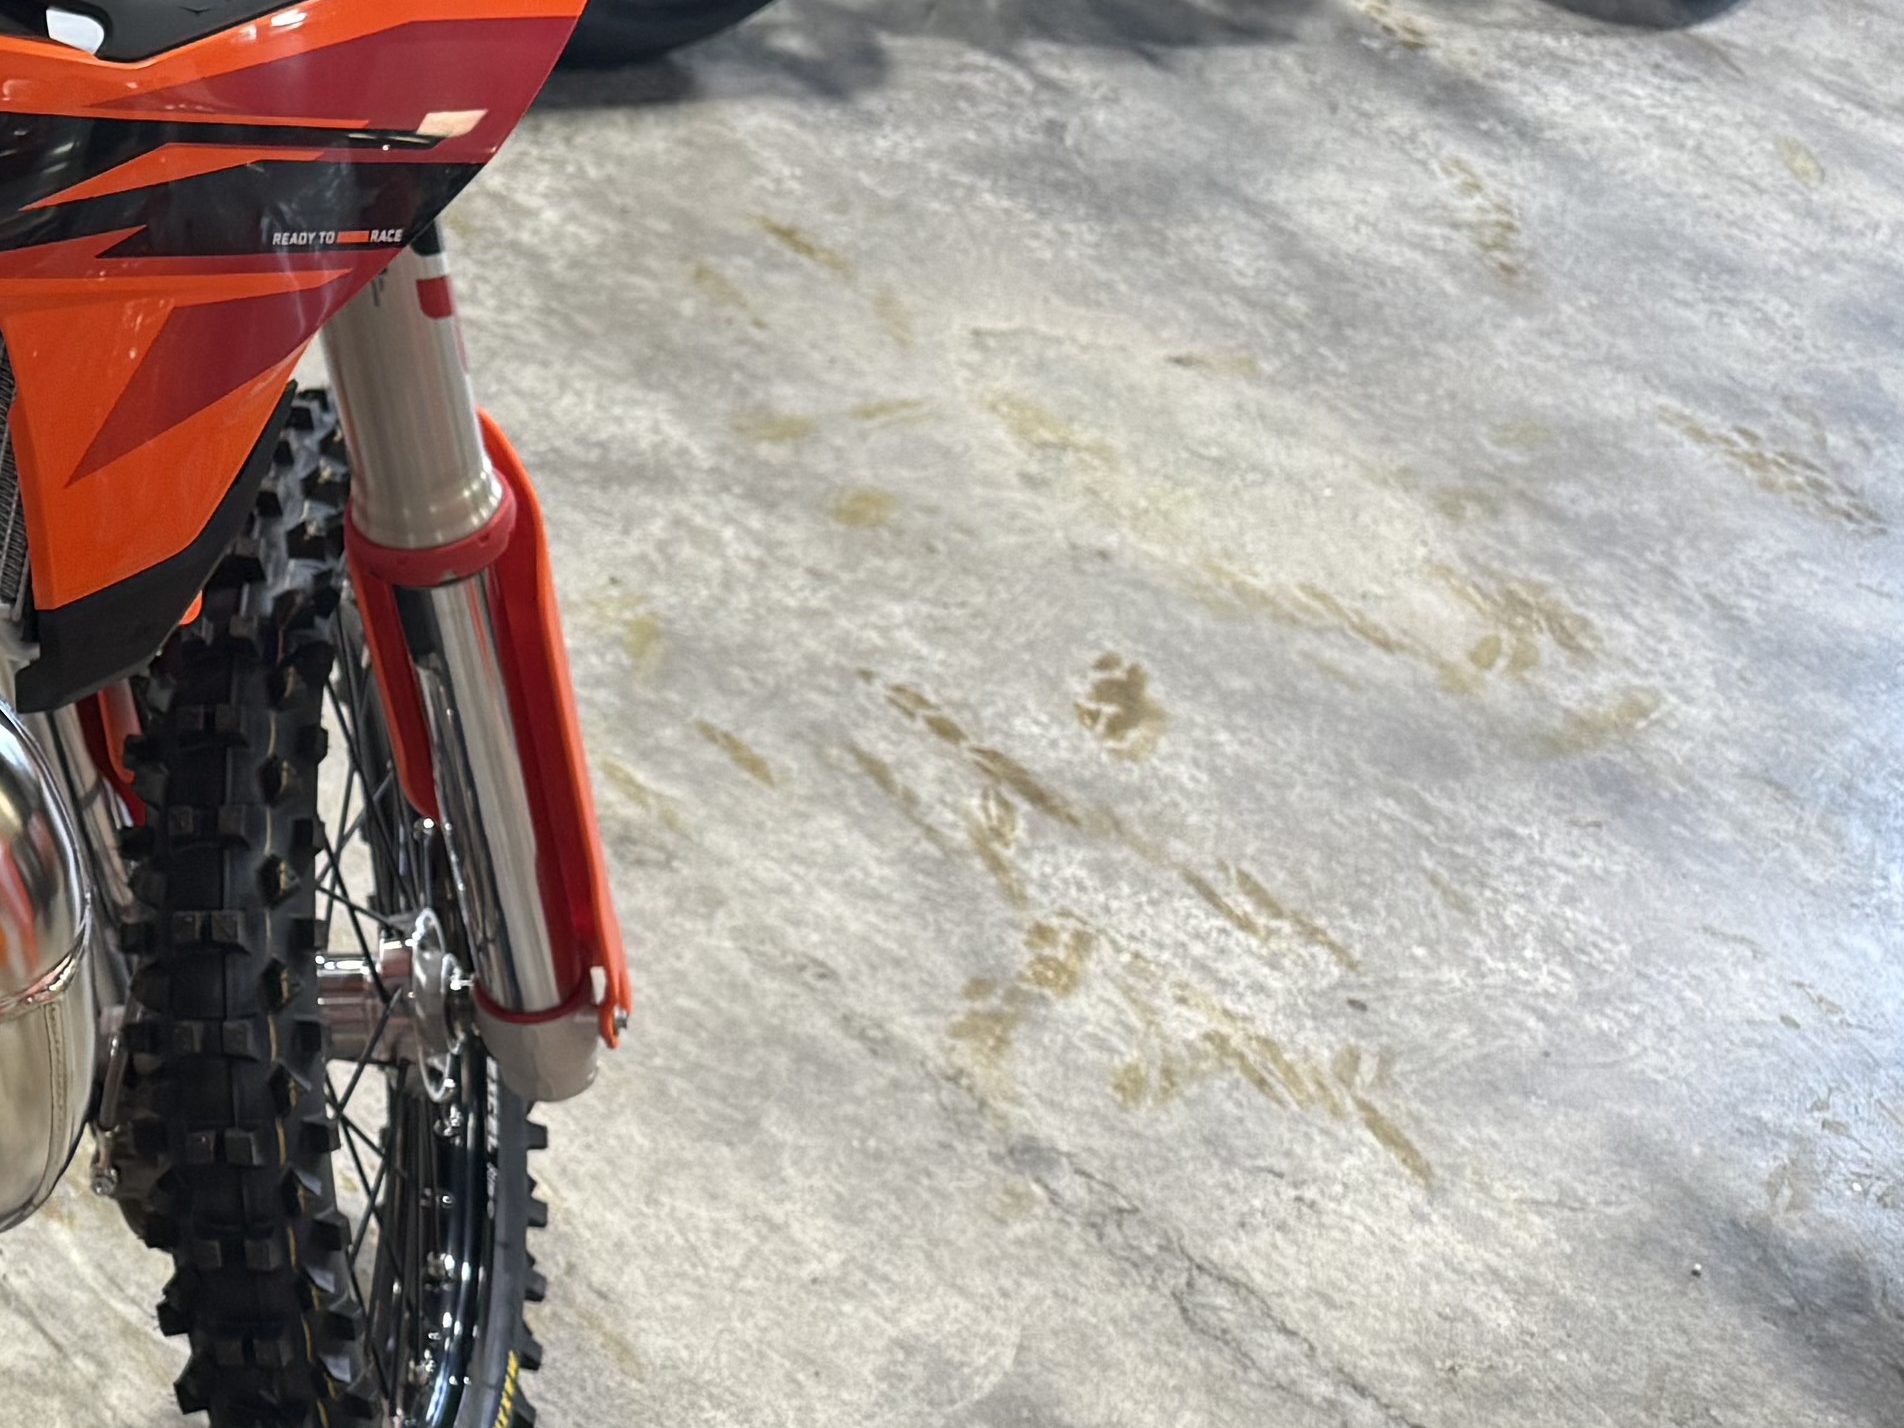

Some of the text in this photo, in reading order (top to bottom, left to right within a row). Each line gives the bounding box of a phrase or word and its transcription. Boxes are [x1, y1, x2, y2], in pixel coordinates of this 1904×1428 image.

[272, 228, 404, 246] READY TO RACE
